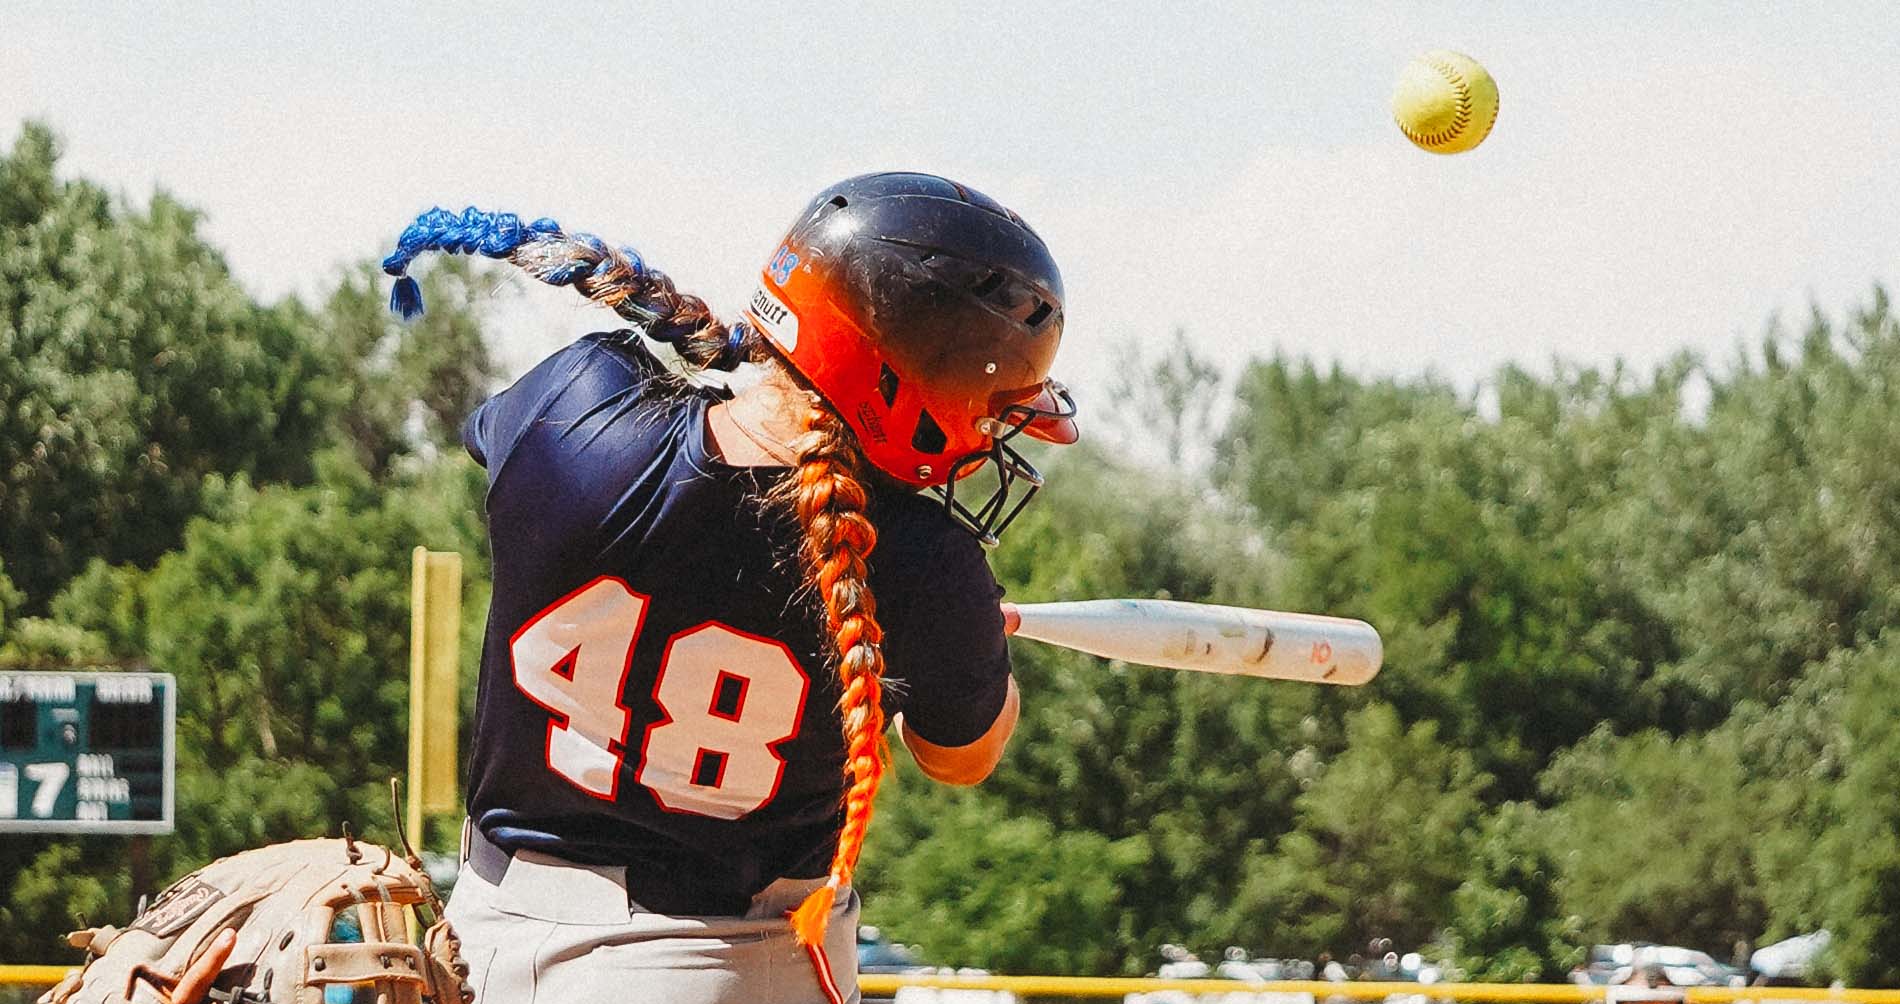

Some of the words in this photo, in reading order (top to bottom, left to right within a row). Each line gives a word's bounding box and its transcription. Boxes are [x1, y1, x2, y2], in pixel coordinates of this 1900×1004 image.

[752, 285, 788, 324] chutt
[509, 574, 811, 820] 48
[24, 762, 70, 818] 7
